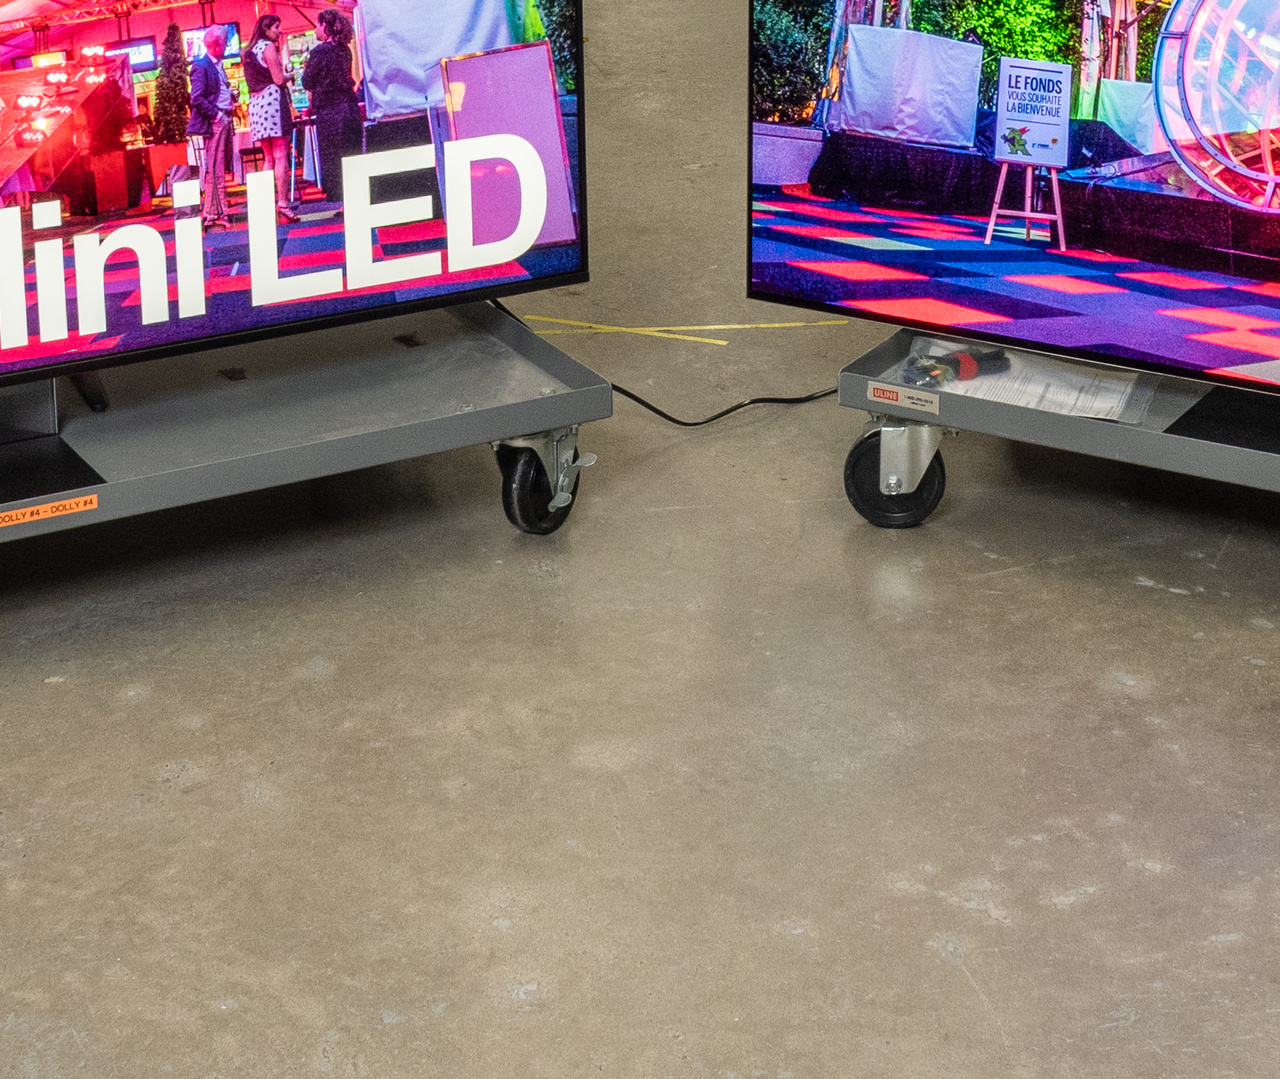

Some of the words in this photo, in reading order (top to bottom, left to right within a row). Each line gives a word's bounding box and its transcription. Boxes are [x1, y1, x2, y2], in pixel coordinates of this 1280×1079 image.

[1008, 74, 1021, 89] LE
[1024, 76, 1062, 94] FONDS
[1008, 91, 1026, 101] VOUS
[1027, 93, 1062, 106] SOUHAITE
[1006, 102, 1016, 112] LA
[1017, 102, 1061, 118] BIENVENUE
[247, 134, 547, 306] LED
[874, 388, 898, 400] ULINE
[29, 509, 40, 518] #4
[50, 501, 81, 514] DOLLY
[83, 498, 94, 507] #4
